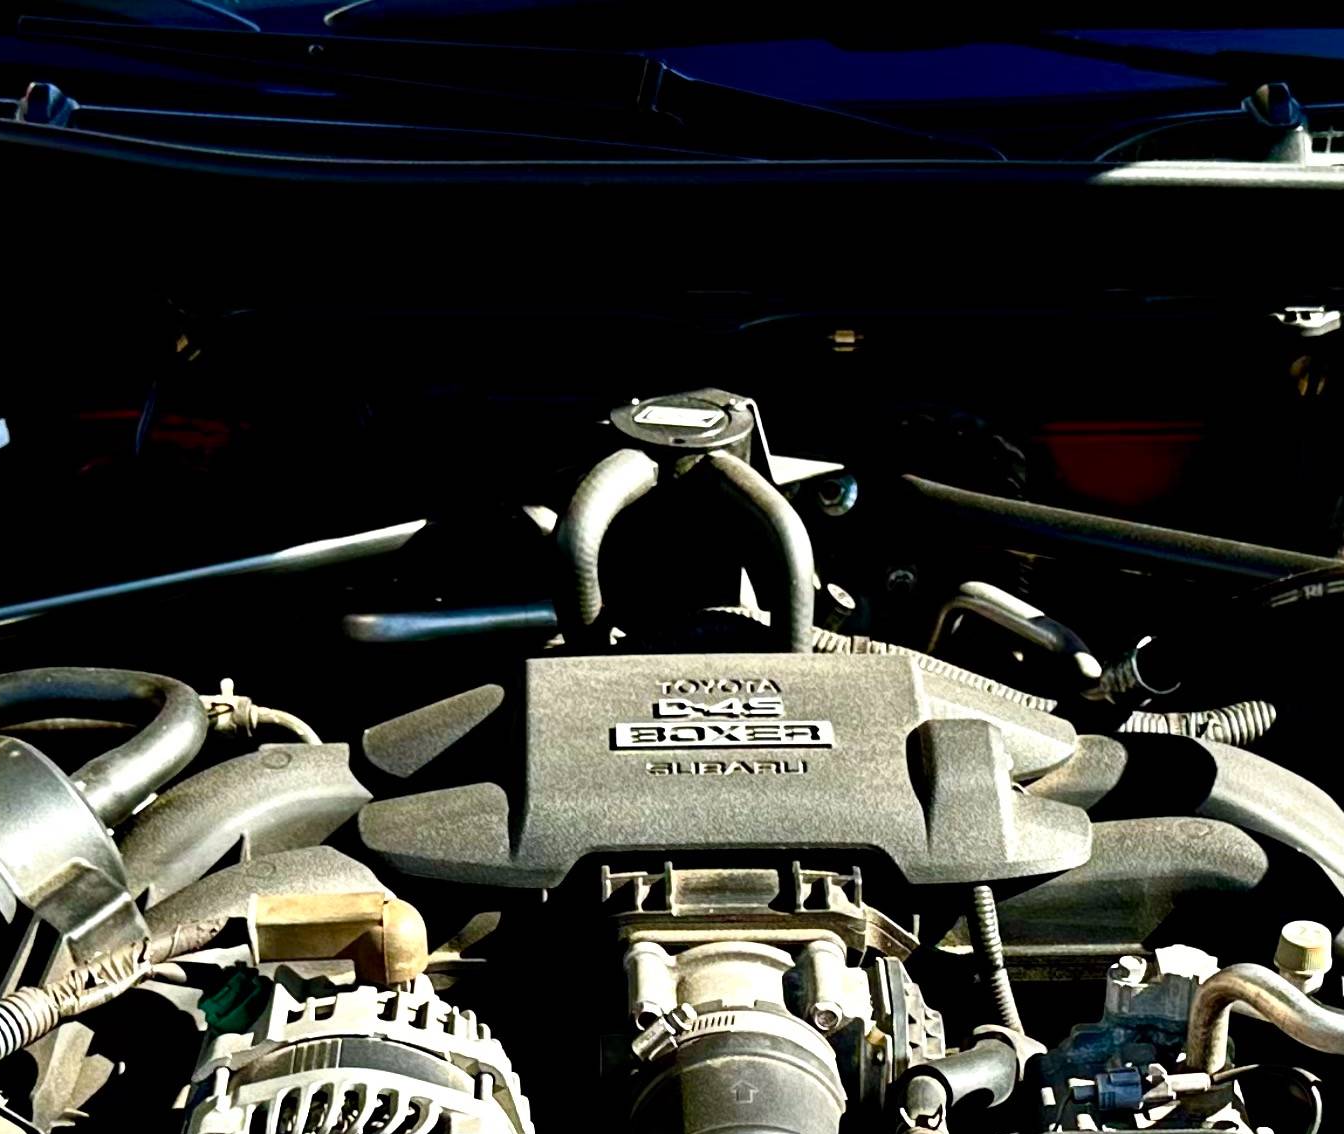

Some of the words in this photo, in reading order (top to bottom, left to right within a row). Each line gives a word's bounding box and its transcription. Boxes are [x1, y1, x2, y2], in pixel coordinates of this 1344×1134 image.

[657, 678, 783, 695] TOYOTA
[652, 697, 784, 719] D-4S
[628, 723, 822, 744] BOXER
[645, 760, 808, 776] SUBARU
